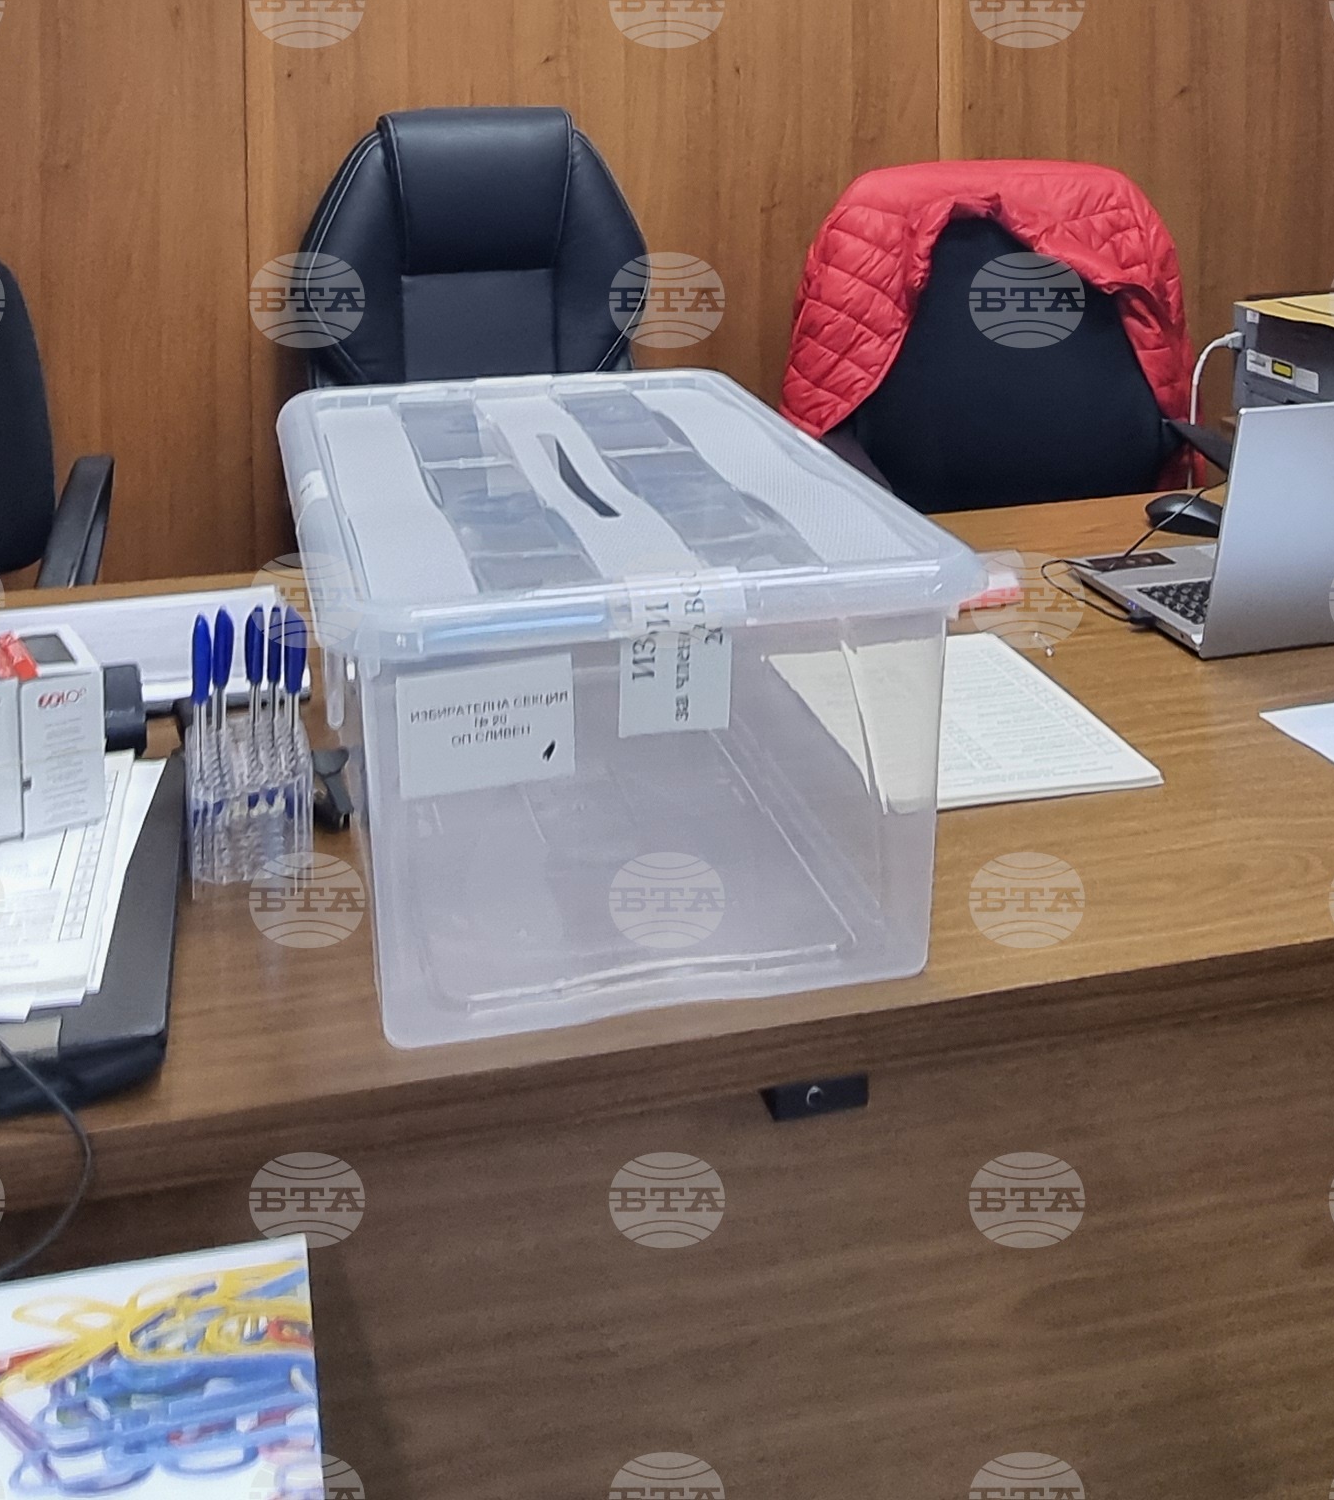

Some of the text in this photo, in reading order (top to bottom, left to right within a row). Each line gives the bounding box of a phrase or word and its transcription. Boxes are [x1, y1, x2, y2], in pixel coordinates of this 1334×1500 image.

[410, 690, 569, 724] ИЗБИРАТЕЛНА СЕКЦИЯ
[675, 694, 689, 722] за
[475, 725, 531, 743] СЛИВЕН
